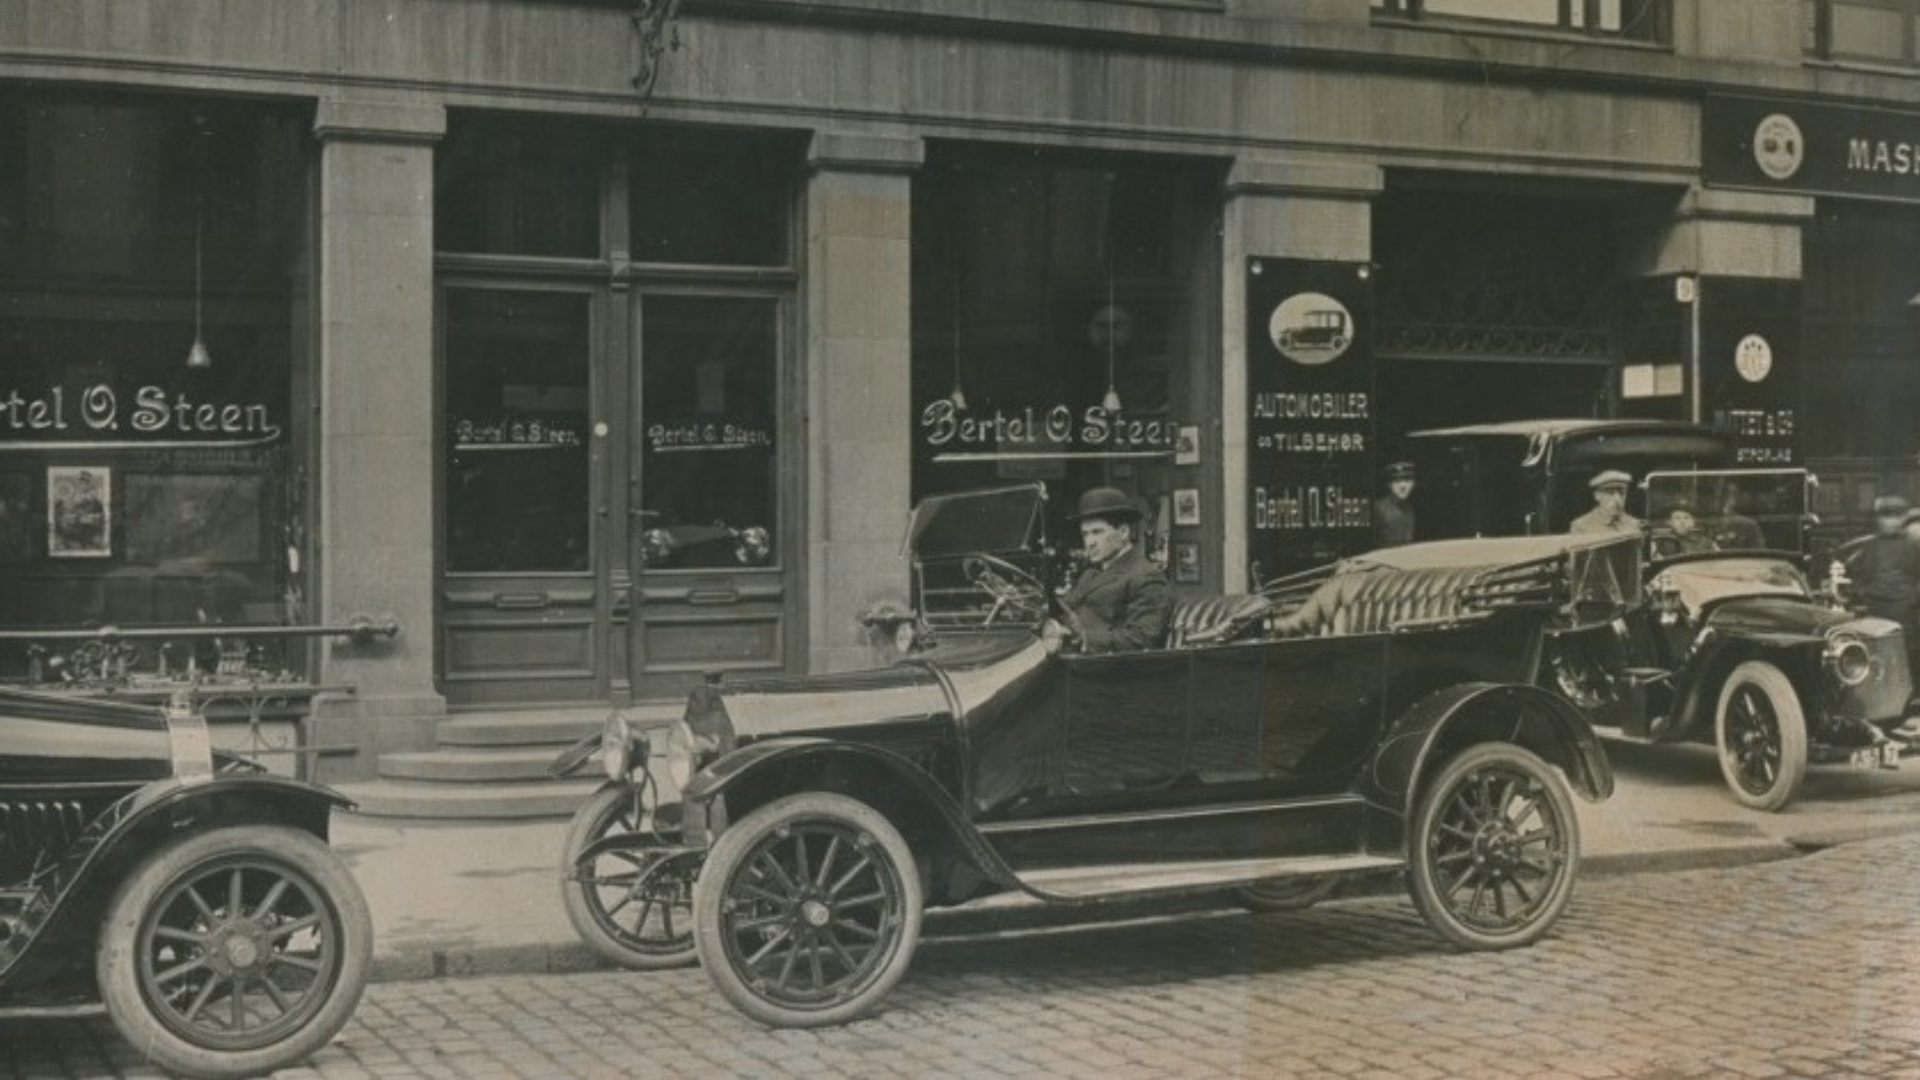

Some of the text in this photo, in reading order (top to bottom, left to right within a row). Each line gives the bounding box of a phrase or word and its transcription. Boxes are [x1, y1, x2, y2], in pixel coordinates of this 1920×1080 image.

[131, 385, 279, 433] Steen
[921, 399, 1036, 445] Bertel
[1254, 392, 1369, 419] AUTOMOBILER
[648, 423, 699, 445] Bertel
[1275, 432, 1365, 452] TILBEHØR
[1255, 486, 1304, 529] Bertel
[1326, 486, 1371, 528] Steen
